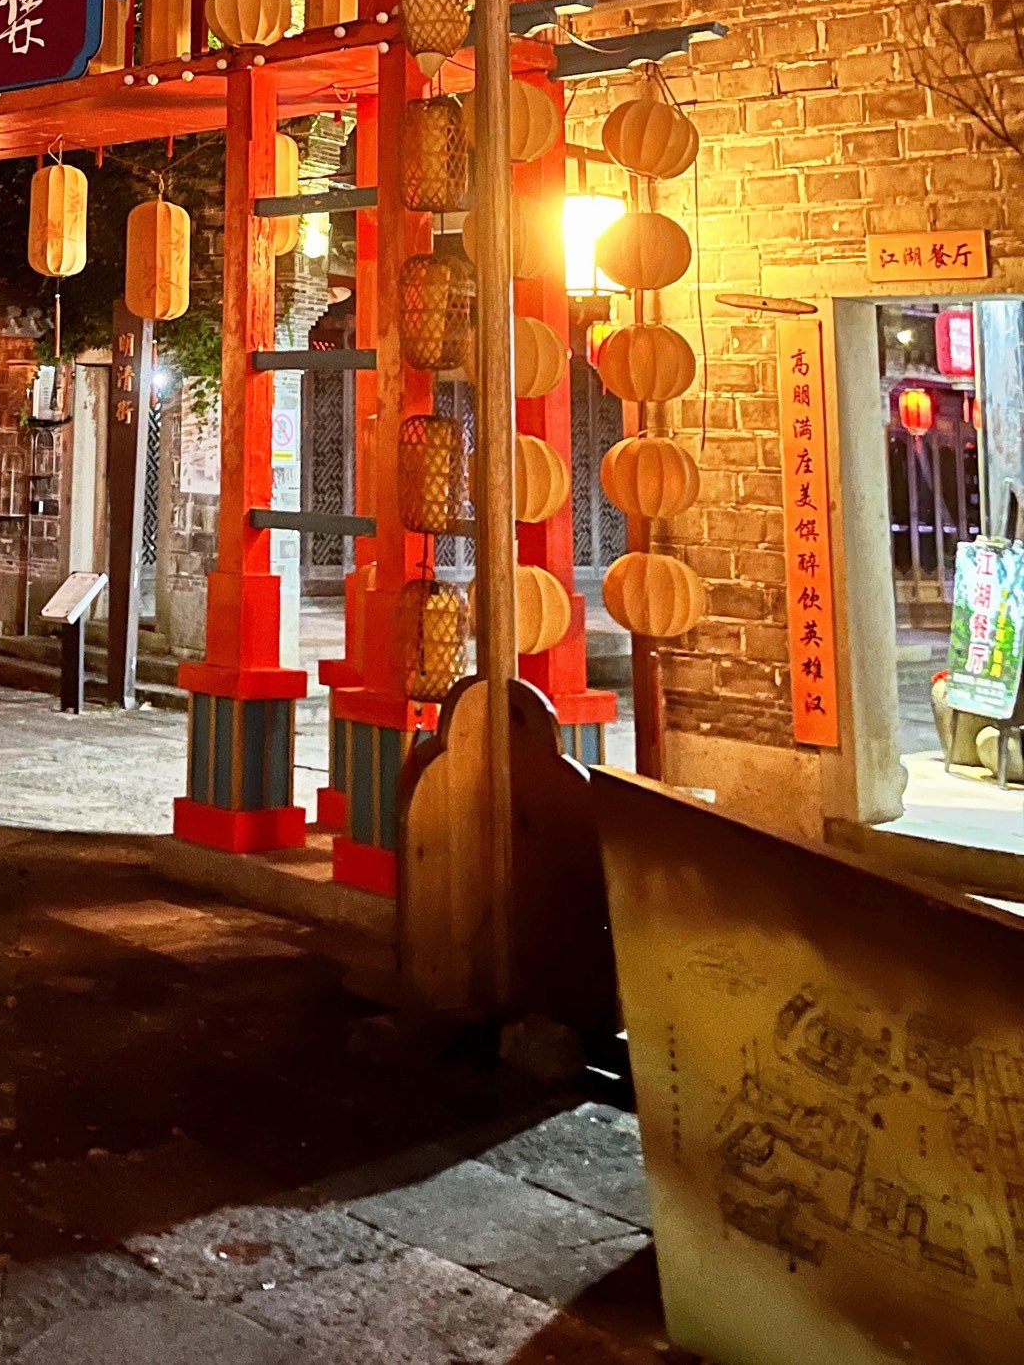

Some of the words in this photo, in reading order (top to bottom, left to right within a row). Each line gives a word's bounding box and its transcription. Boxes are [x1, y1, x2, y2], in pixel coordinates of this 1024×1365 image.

[880, 243, 972, 269] 江湖餐厅
[116, 332, 135, 425] 明清街
[790, 348, 826, 715] 高朋满座美馔醉饮英雄汉
[967, 553, 994, 673] 江湖餐厅
